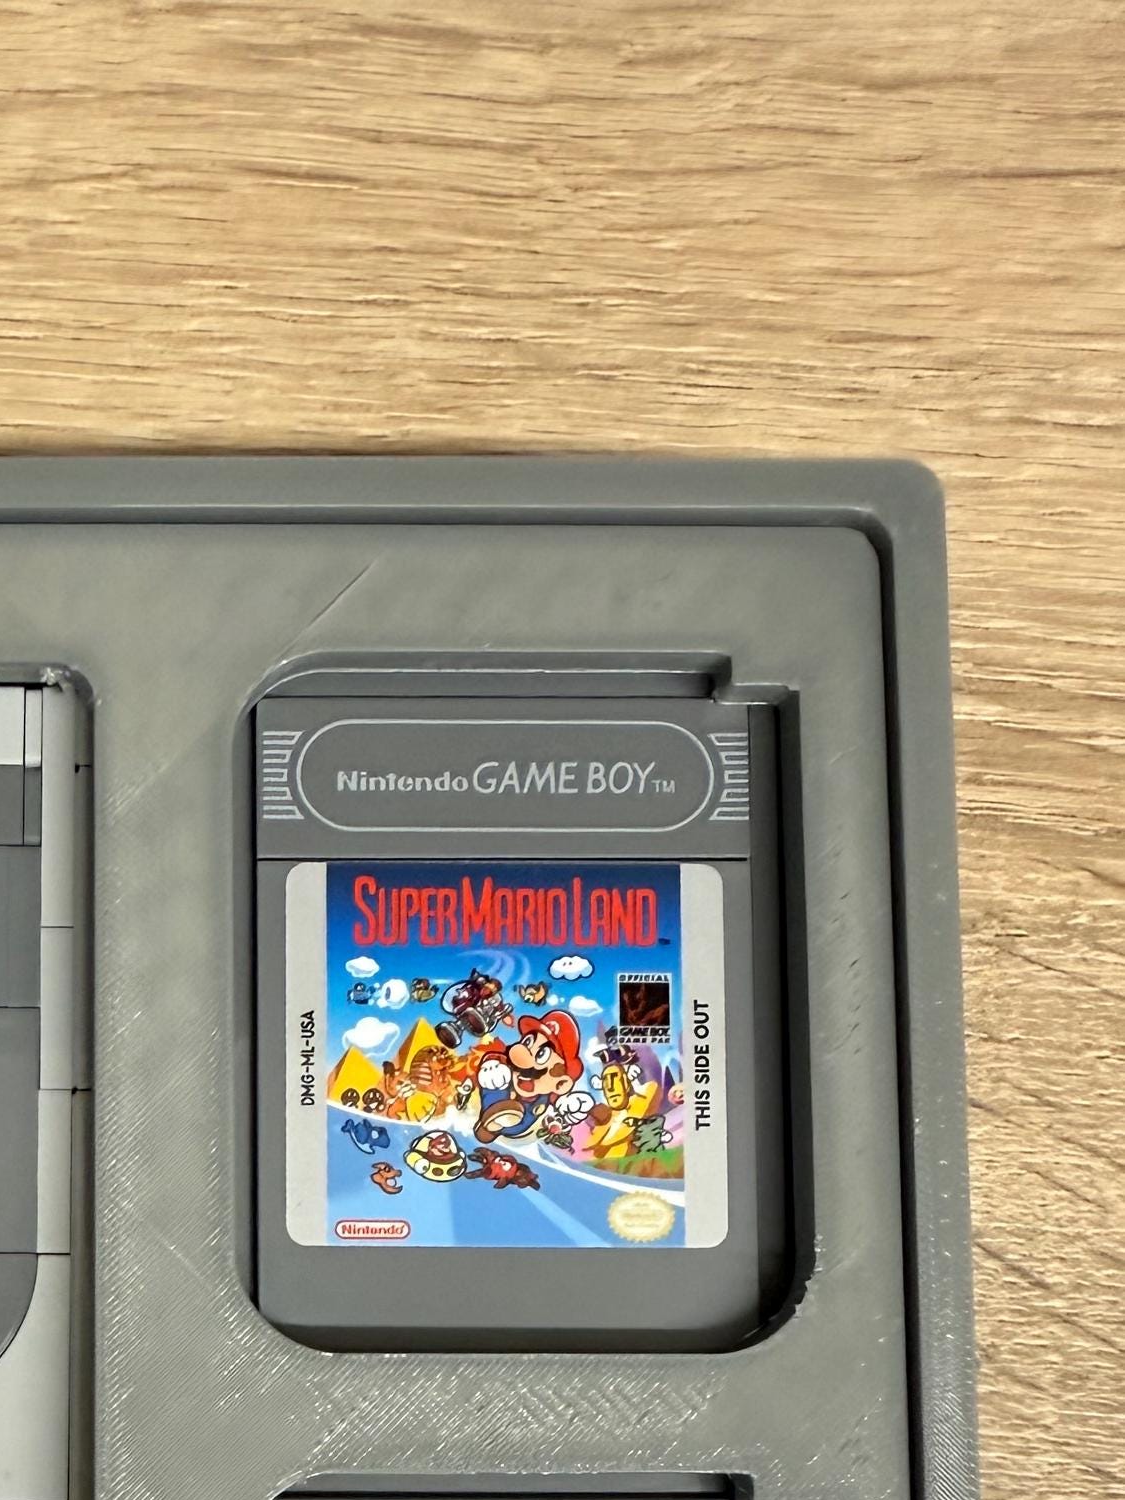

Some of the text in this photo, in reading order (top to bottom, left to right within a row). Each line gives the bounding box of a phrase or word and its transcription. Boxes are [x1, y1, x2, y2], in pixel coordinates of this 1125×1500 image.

[336, 769, 469, 793] Nintendo
[473, 761, 579, 795] GAME
[352, 874, 658, 947] SUPER MARIO LAND
[299, 1009, 316, 1106] DMG-ML-USA
[693, 999, 711, 1131] THIS SIDE OUT
